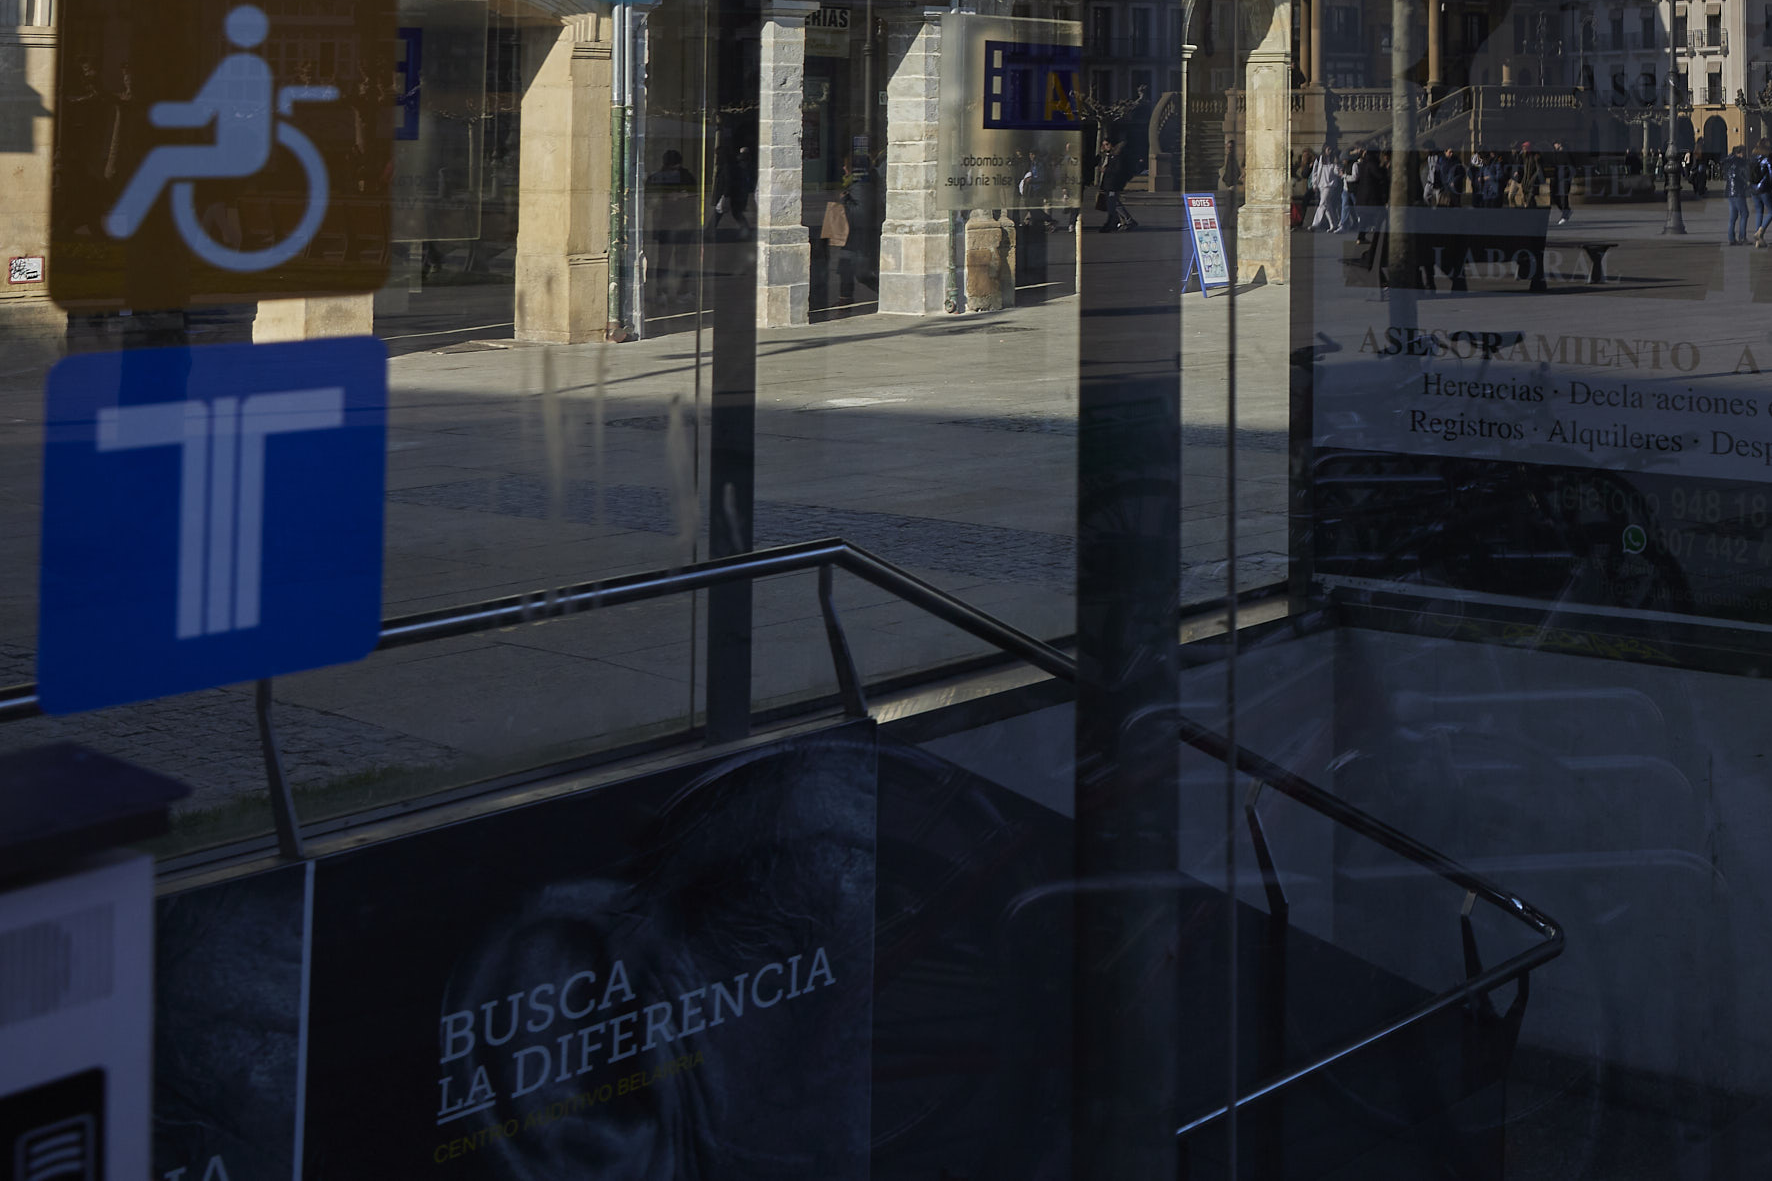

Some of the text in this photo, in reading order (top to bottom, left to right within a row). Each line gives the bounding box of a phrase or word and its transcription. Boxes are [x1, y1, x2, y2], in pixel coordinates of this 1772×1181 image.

[1358, 325, 1701, 373] ASESORAMIENTO
[1733, 344, 1762, 375] A
[1422, 372, 1545, 404] Herencias
[1569, 380, 1757, 418] Declaaciones
[1409, 410, 1525, 442] Registros
[1548, 418, 1683, 454] Alquileres
[1671, 487, 1721, 523] 948
[1734, 491, 1767, 529] 18
[436, 946, 837, 1119] LA DIFERENCIA
[439, 959, 637, 1065] BUSCA
[432, 1114, 521, 1165] CENTRO
[522, 1083, 614, 1132] AUDITIVO
